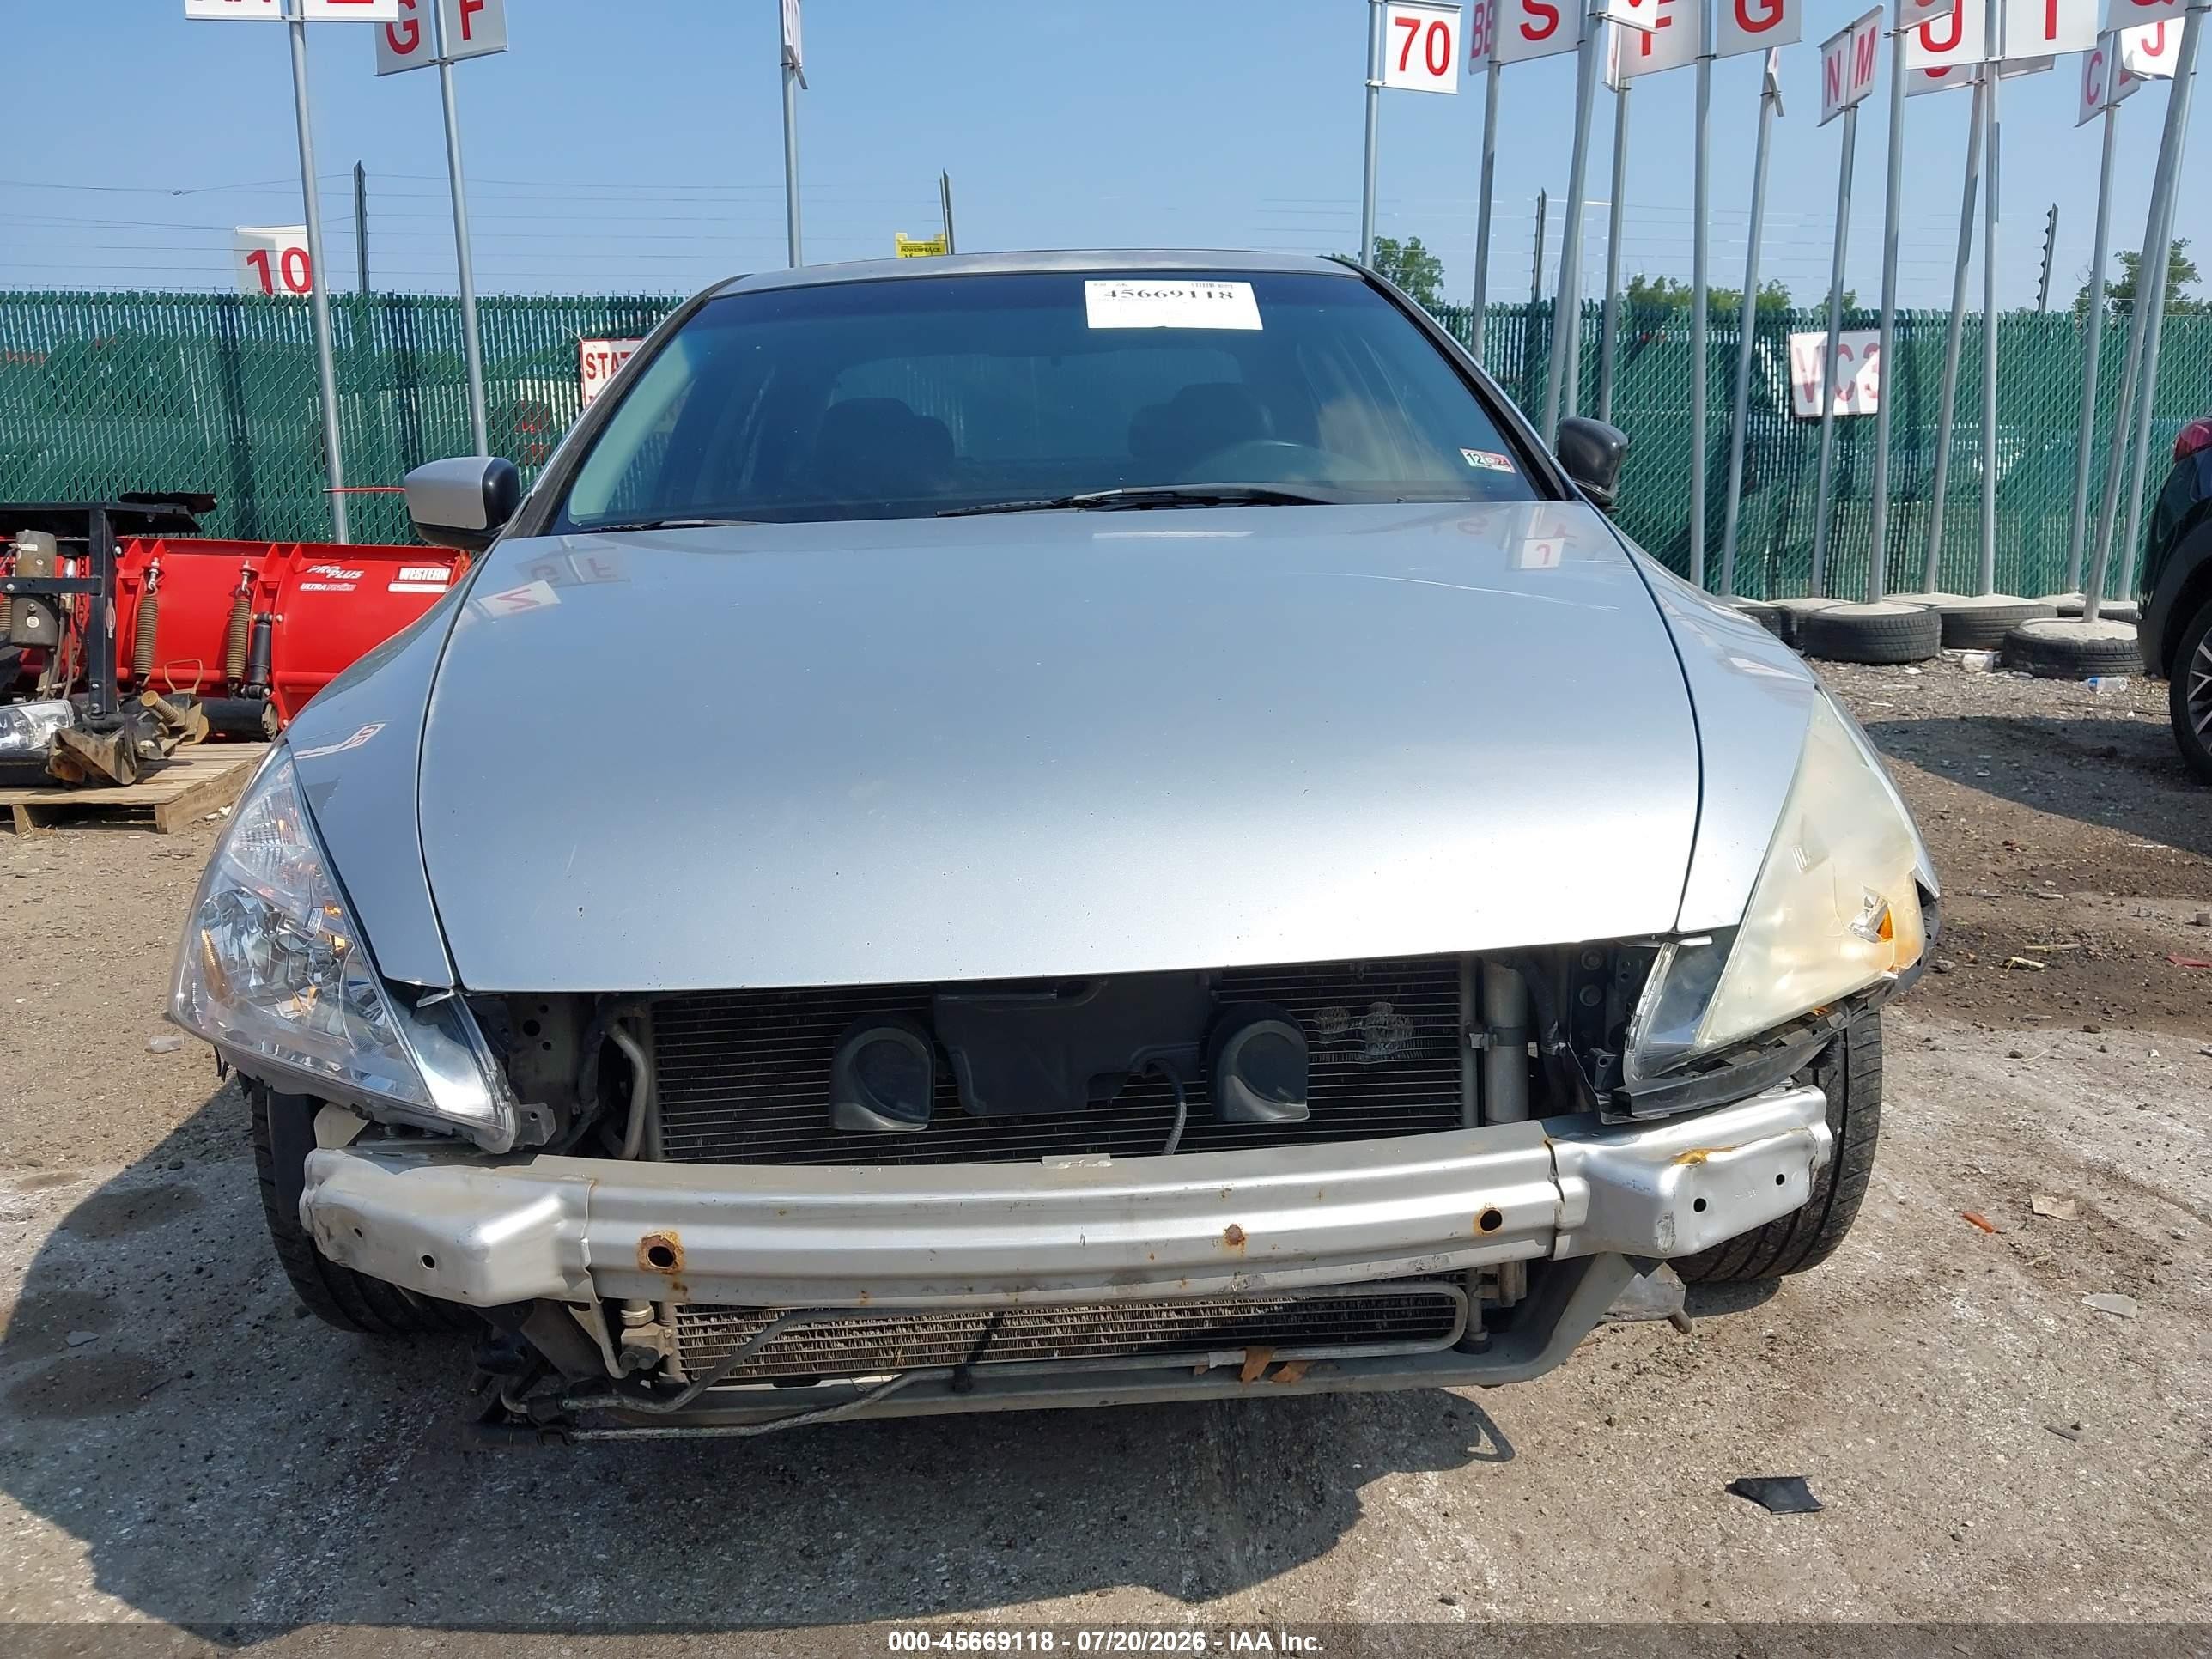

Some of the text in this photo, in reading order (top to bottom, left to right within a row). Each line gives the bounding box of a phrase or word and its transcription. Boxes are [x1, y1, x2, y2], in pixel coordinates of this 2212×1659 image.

[1395, 17, 1451, 76] 70
[1826, 26, 1877, 108] N M
[246, 247, 313, 295] 10
[1103, 289, 1234, 300] 45669118
[586, 351, 632, 380] STA
[398, 567, 452, 581] WESTERN
